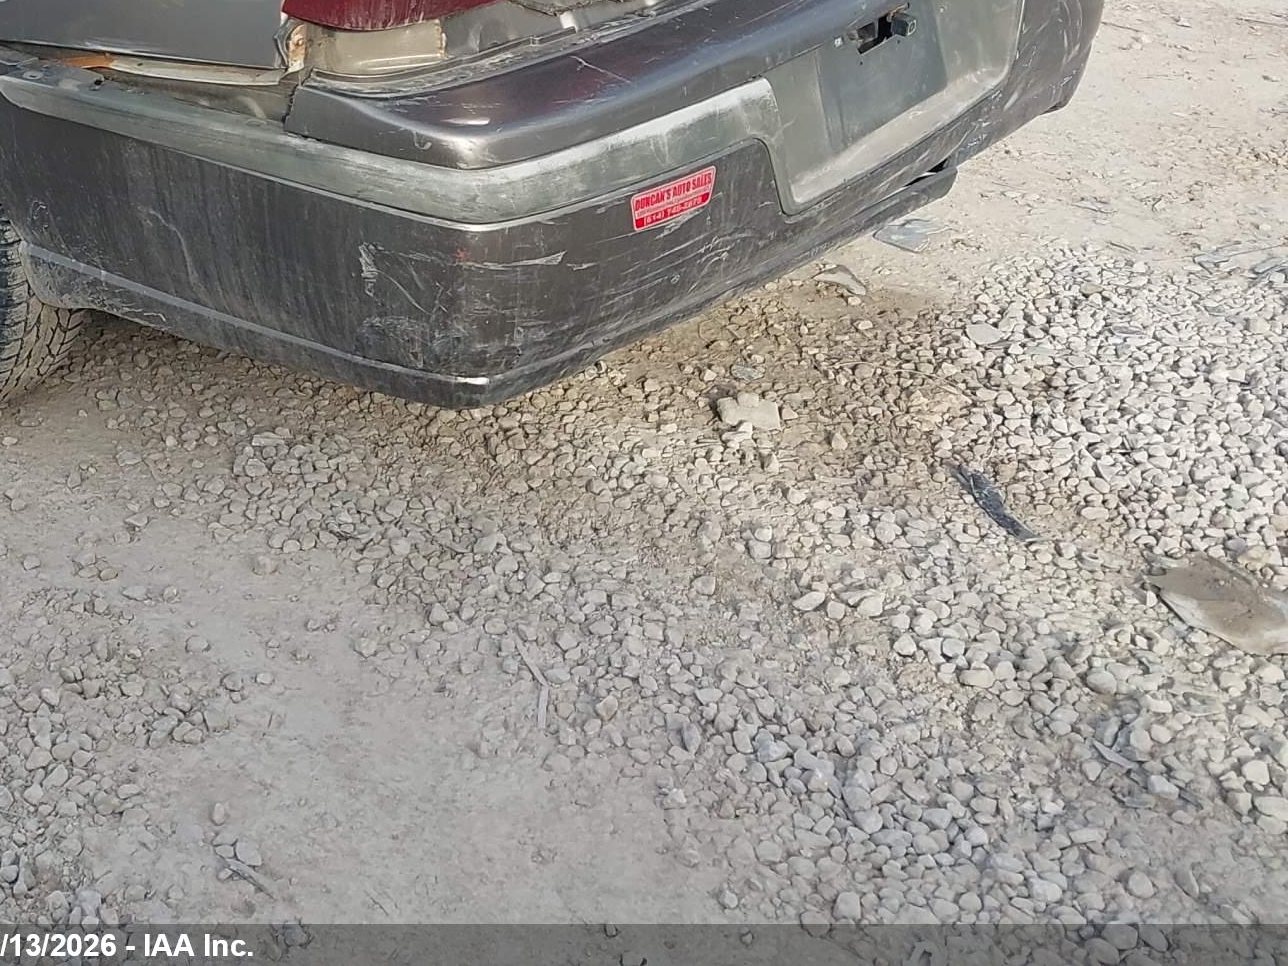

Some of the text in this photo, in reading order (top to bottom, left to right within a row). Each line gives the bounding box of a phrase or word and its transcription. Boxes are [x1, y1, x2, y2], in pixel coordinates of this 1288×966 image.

[634, 186, 671, 211] DUNCAN'S
[672, 180, 691, 200] AUTO
[692, 172, 712, 189] SALES
